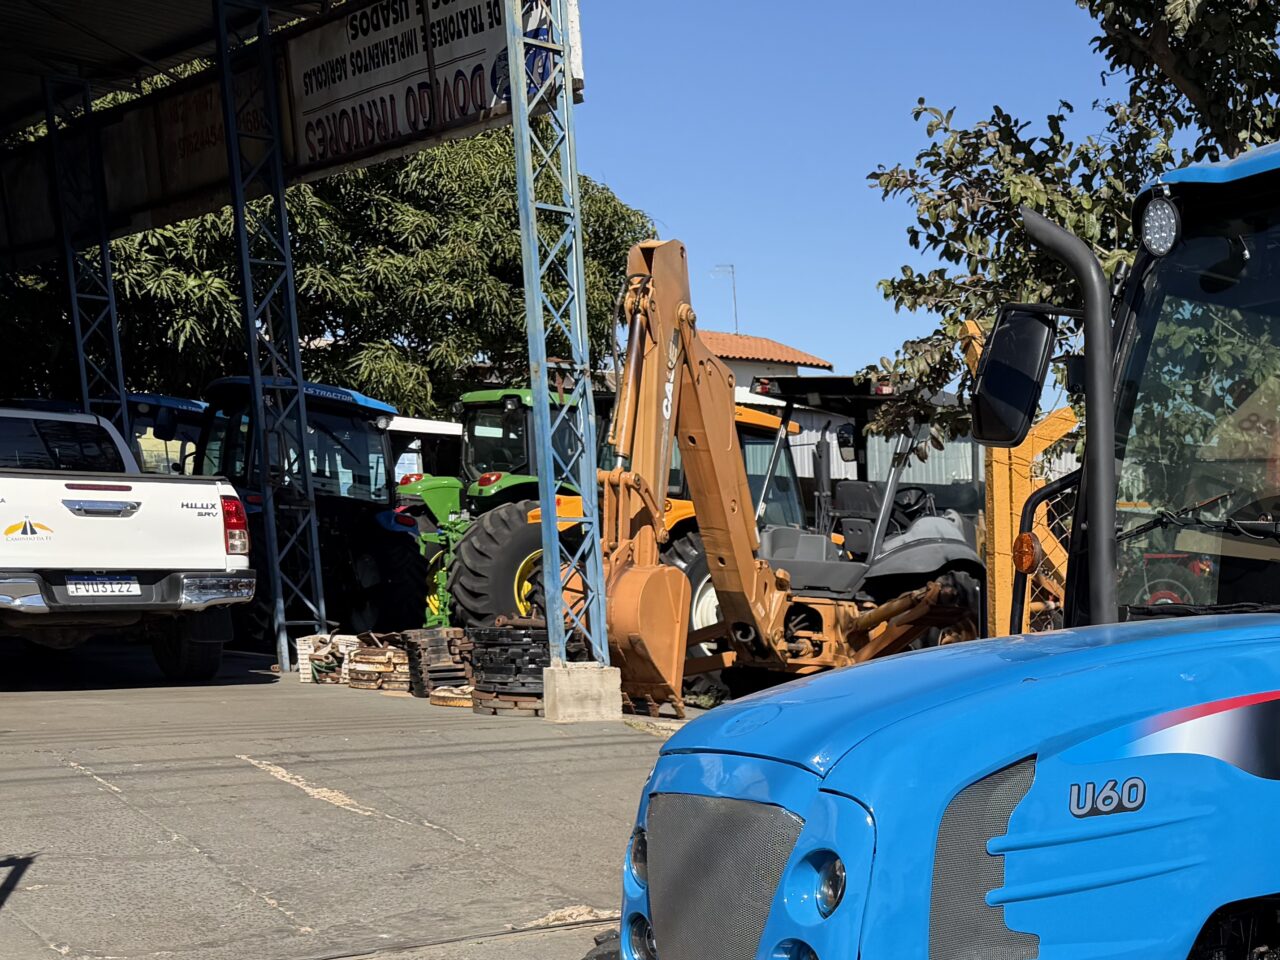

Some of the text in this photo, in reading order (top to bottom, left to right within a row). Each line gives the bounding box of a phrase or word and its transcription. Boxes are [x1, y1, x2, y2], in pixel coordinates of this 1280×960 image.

[431, 5, 484, 49] TRATORES
[487, 0, 501, 30] DE
[350, 28, 418, 76] IMPLEMENTOS
[303, 54, 347, 96] AGRÍCOLAS
[305, 95, 399, 160] TRATORES
[181, 502, 217, 510] HILUX
[1069, 777, 1146, 818] U60
